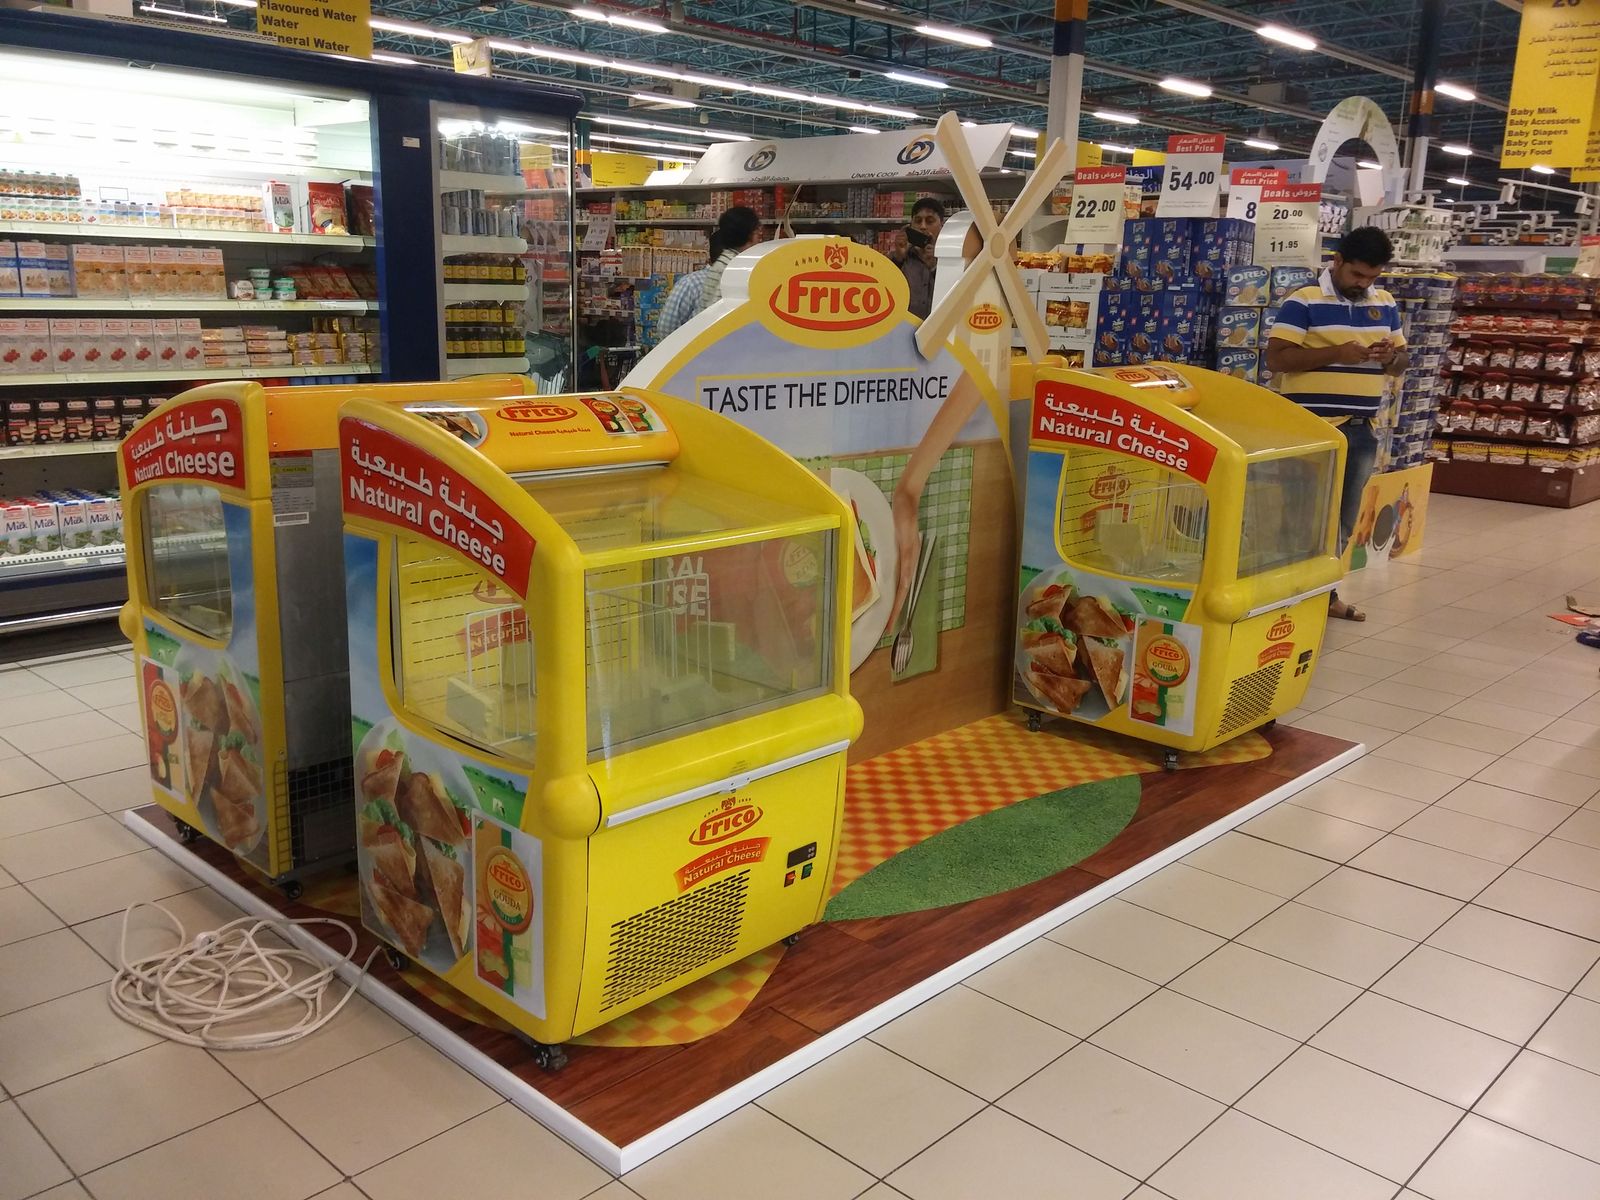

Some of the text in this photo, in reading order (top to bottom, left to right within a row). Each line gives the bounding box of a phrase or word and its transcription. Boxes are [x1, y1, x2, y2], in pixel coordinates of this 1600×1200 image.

[259, 0, 357, 23] Flavoured Water
[261, 14, 299, 29] Water
[313, 37, 350, 52] Water
[1510, 106, 1558, 117] Baby Milk
[1509, 117, 1581, 128] Baby Accessories
[1507, 128, 1568, 138] Baby Diapers
[1506, 138, 1553, 148] Baby Care
[1504, 148, 1552, 158] Baby Food
[1077, 171, 1099, 180] Deals
[1169, 171, 1215, 191] 54.00
[1263, 189, 1290, 198] Deals
[1075, 200, 1115, 218] 22.00
[1273, 209, 1303, 220] 20.00
[1270, 240, 1298, 252] 11.95
[795, 255, 819, 267] ANNO
[1230, 269, 1268, 283] OREO
[1276, 271, 1314, 283] OREO
[1222, 312, 1258, 325] OREO
[1221, 352, 1256, 365] OREO
[703, 376, 948, 414] TASTE THE DIFFERENCE
[1044, 393, 1190, 453] جبنة طبيعية
[131, 407, 228, 460] جبنة طبيعية
[1040, 416, 1188, 472] Natural Cheese
[134, 450, 235, 485] Natural Cheese
[351, 438, 505, 545] جبنة طبيعية
[34, 519, 56, 530] Milk
[63, 515, 85, 527] Milk
[89, 513, 111, 524] Milk
[6, 521, 28, 533] Milk
[350, 475, 506, 576] Natural Cheese
[1152, 661, 1178, 673] GOUDA
[683, 850, 761, 885] Natural Cheese
[493, 889, 521, 911] GOUDA
